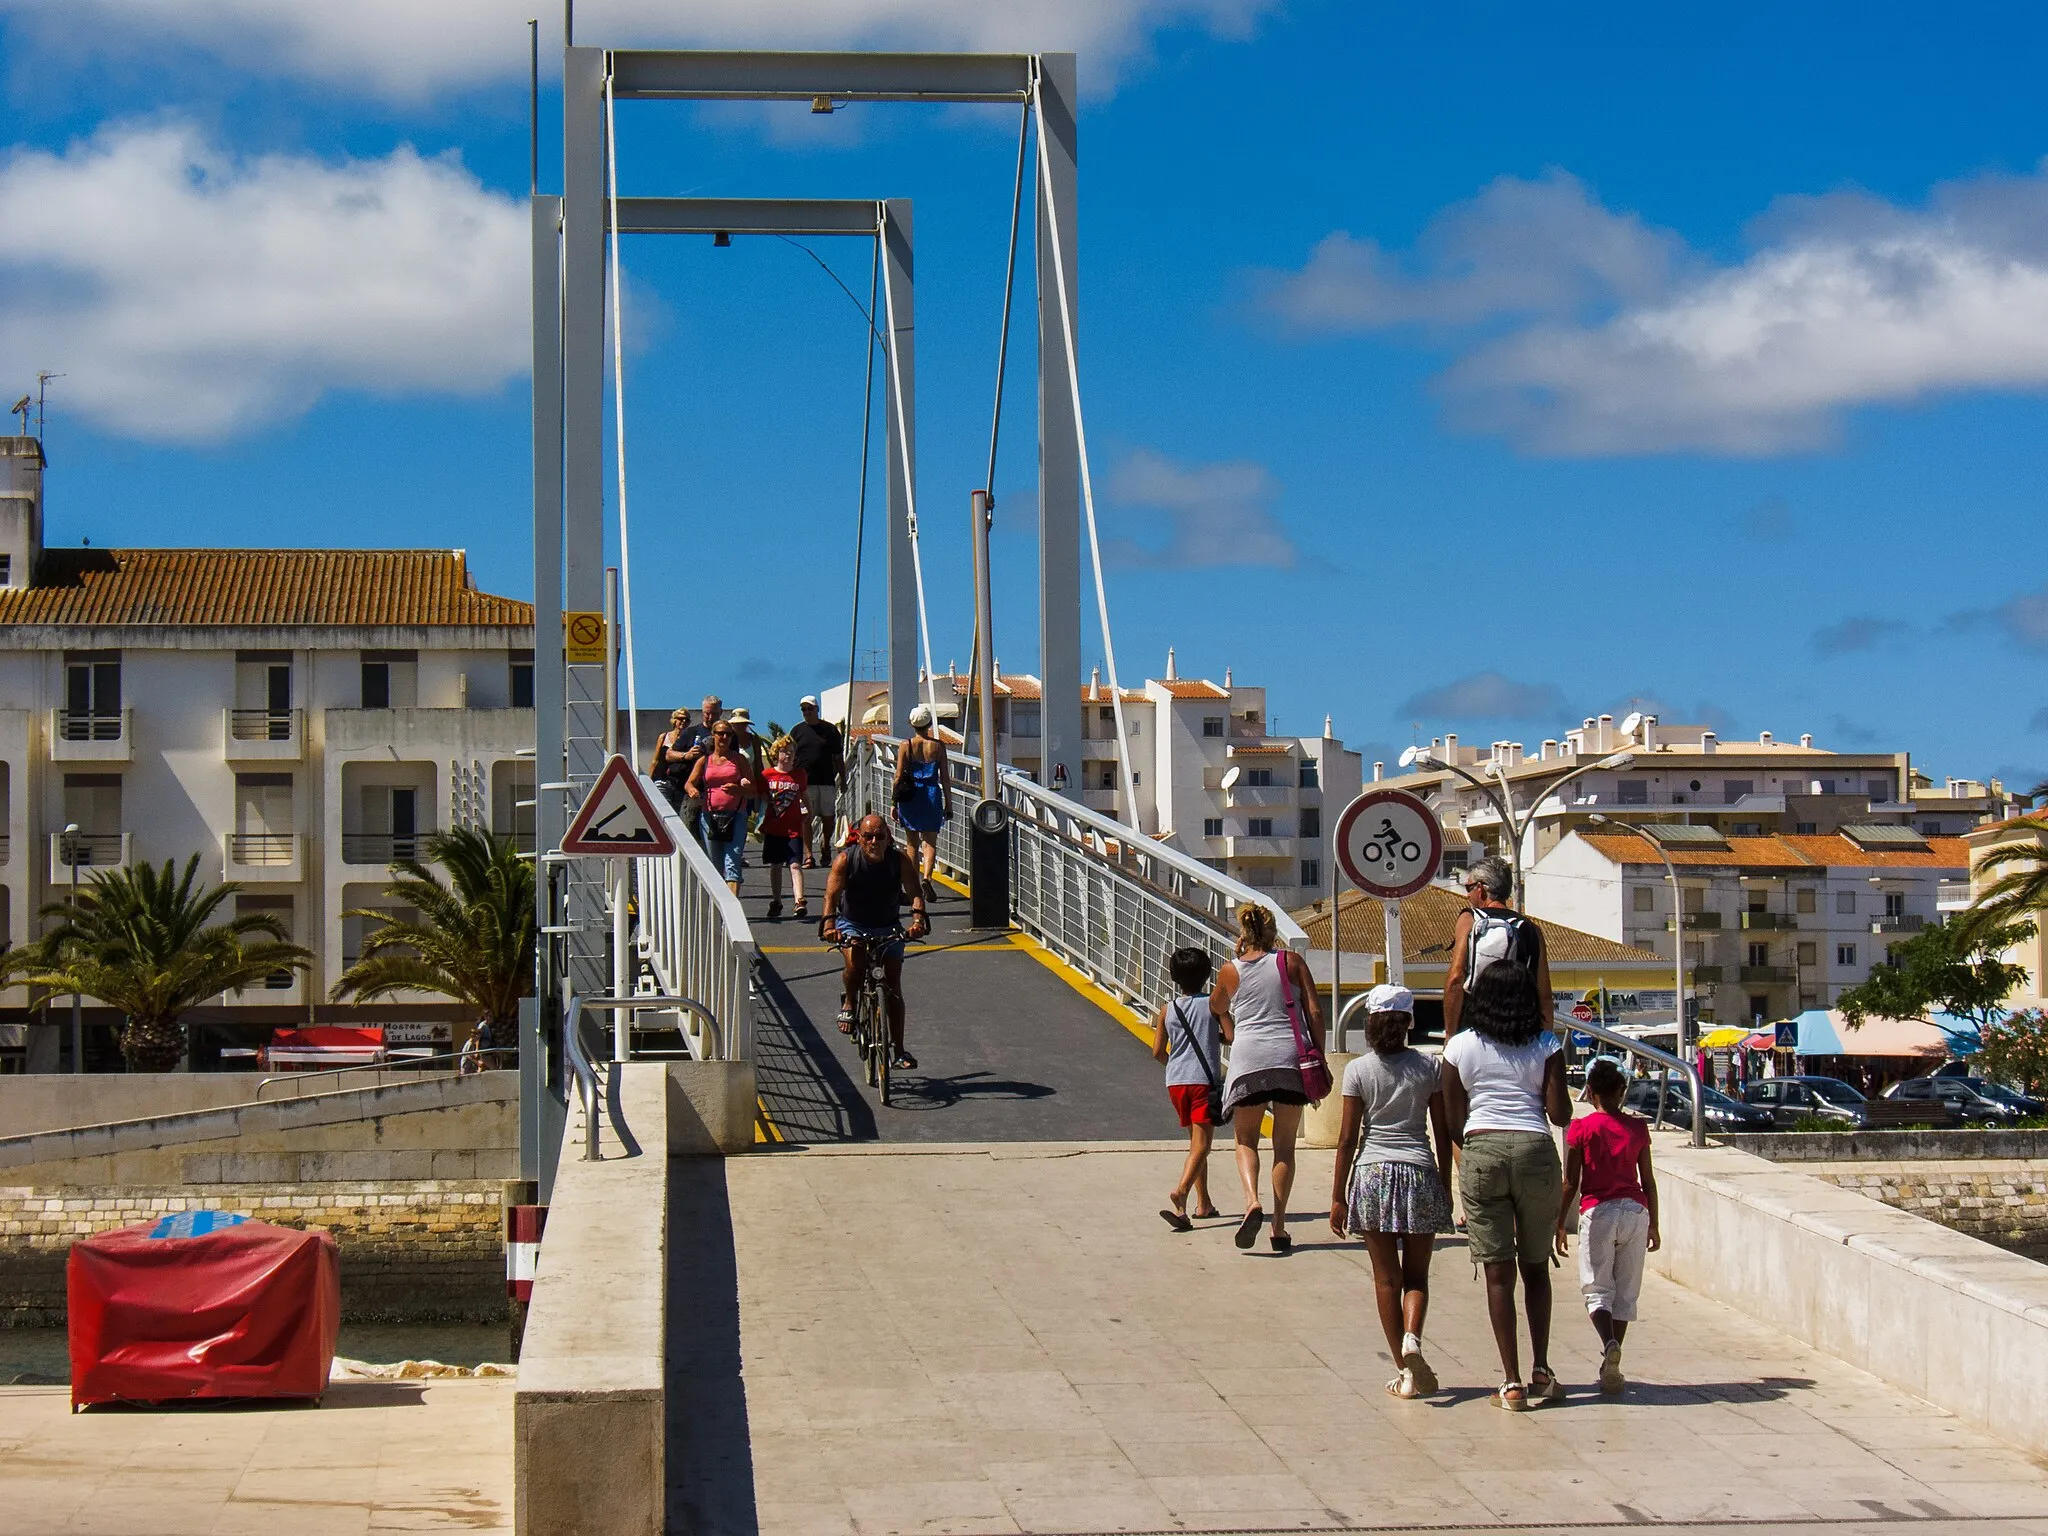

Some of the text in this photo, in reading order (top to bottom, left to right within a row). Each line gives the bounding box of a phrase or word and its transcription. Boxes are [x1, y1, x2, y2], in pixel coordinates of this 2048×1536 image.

[778, 781, 799, 791] DIEGO
[1611, 994, 1638, 1007] EVA
[1572, 1011, 1591, 1019] STOP
[405, 1033, 432, 1041] LAGOS
